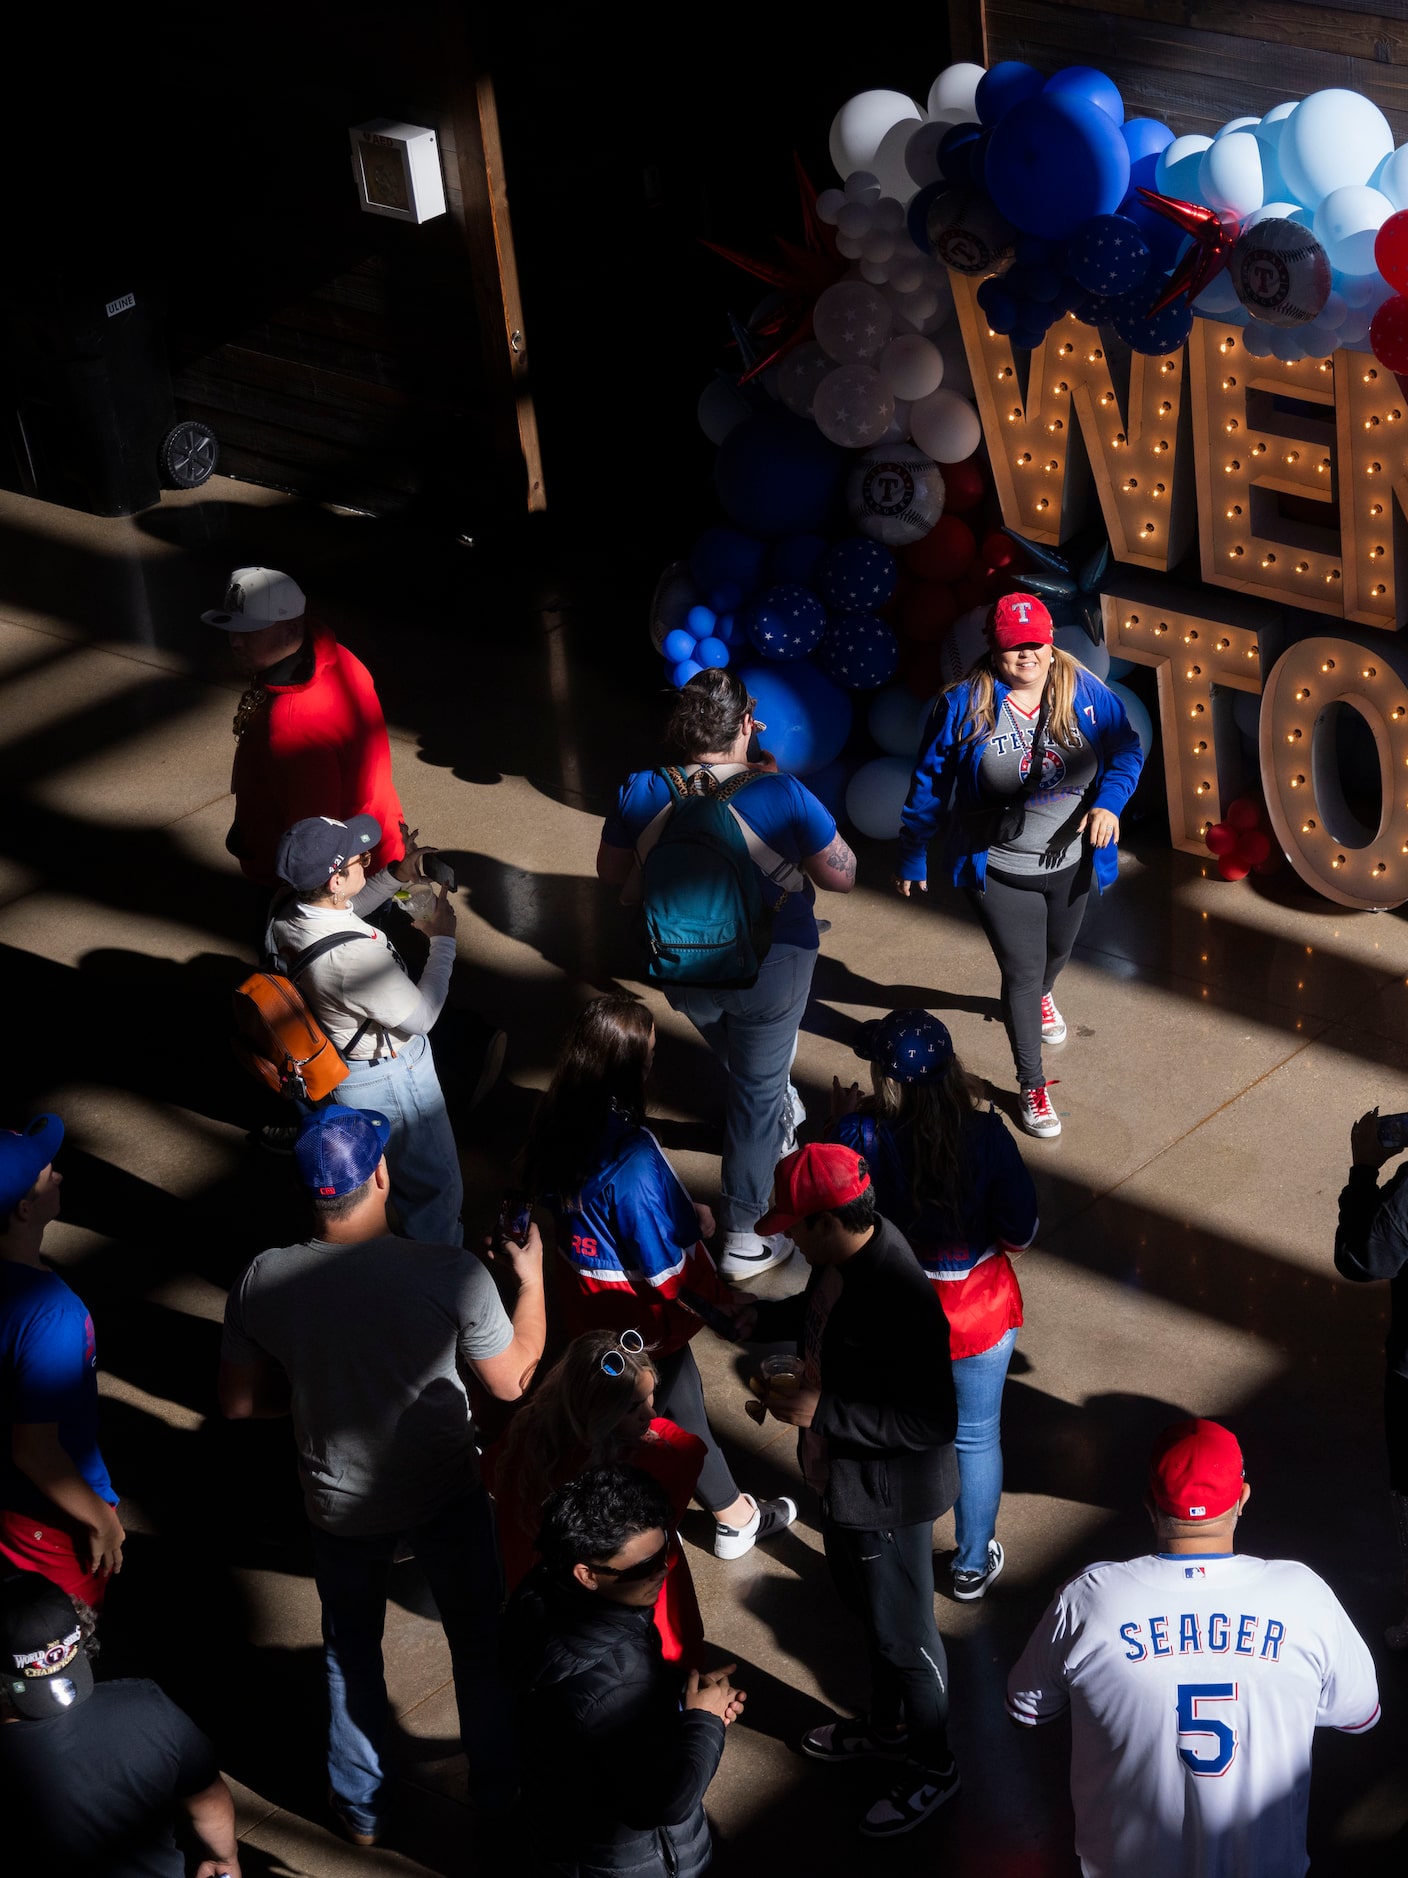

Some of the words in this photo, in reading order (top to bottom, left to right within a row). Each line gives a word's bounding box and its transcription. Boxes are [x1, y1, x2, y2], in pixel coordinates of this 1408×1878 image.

[372, 134, 394, 147] AED
[108, 296, 134, 314] ULINE
[878, 478, 899, 502] T
[1011, 602, 1032, 624] T
[1119, 1613, 1287, 1663] SEAGER
[13, 1650, 46, 1669] WORLD
[1175, 1682, 1239, 1778] 5
